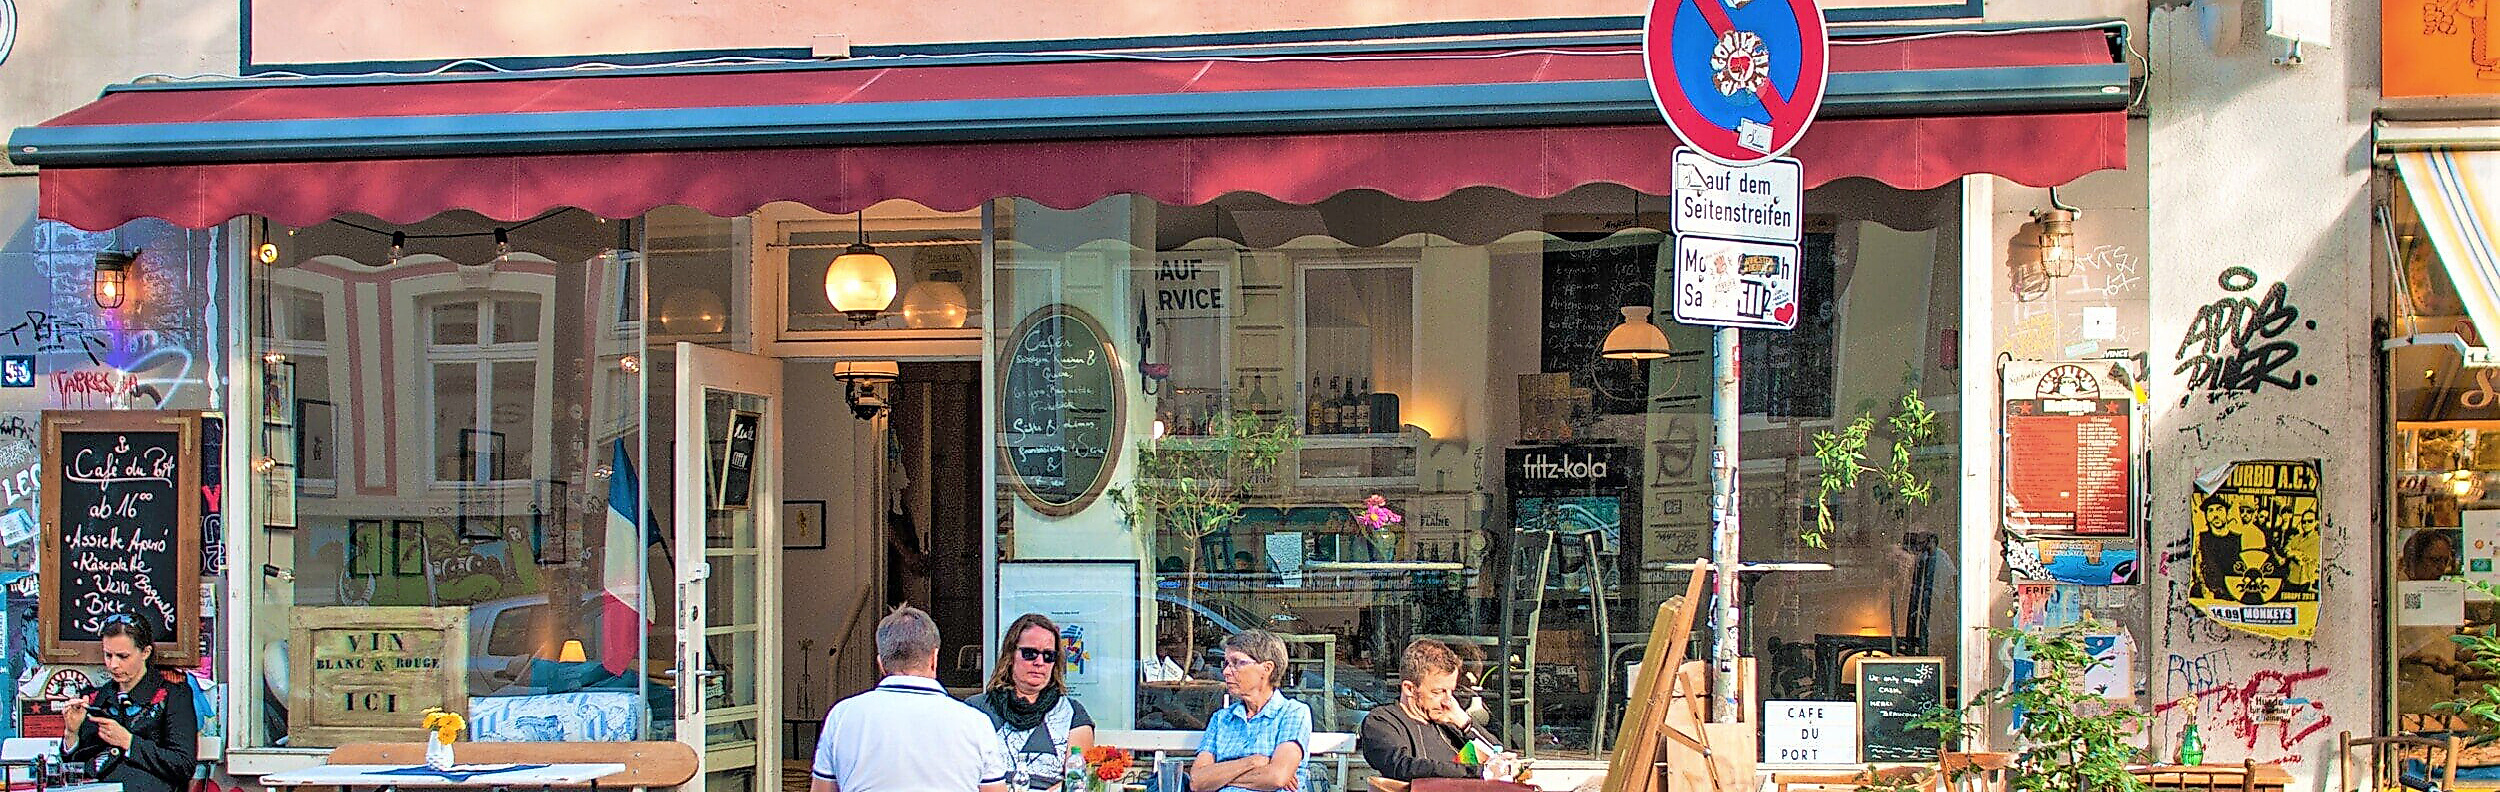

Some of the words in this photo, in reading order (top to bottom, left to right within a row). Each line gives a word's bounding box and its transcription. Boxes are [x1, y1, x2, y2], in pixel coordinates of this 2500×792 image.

[1706, 171, 1731, 191] auf
[1740, 172, 1771, 195] dem
[1684, 196, 1791, 227] Seitenstreifen
[1155, 259, 1203, 280] AUF
[1156, 288, 1224, 310] RVICE
[1684, 283, 1703, 307] Sa
[75, 448, 119, 491] Café
[126, 456, 147, 476] du
[1523, 453, 1607, 479] fritz-kola
[2226, 464, 2274, 488] TURBO
[90, 494, 112, 519] ab
[2244, 608, 2292, 619] MONKEYS
[348, 632, 405, 653] VIN
[316, 658, 365, 670] BLANC
[374, 658, 385, 672] &
[396, 656, 440, 670] ROUGE
[345, 692, 397, 713] ICI
[1787, 707, 1824, 719] CAFE
[1801, 728, 1819, 739] DU
[1781, 749, 1818, 760] PORT
